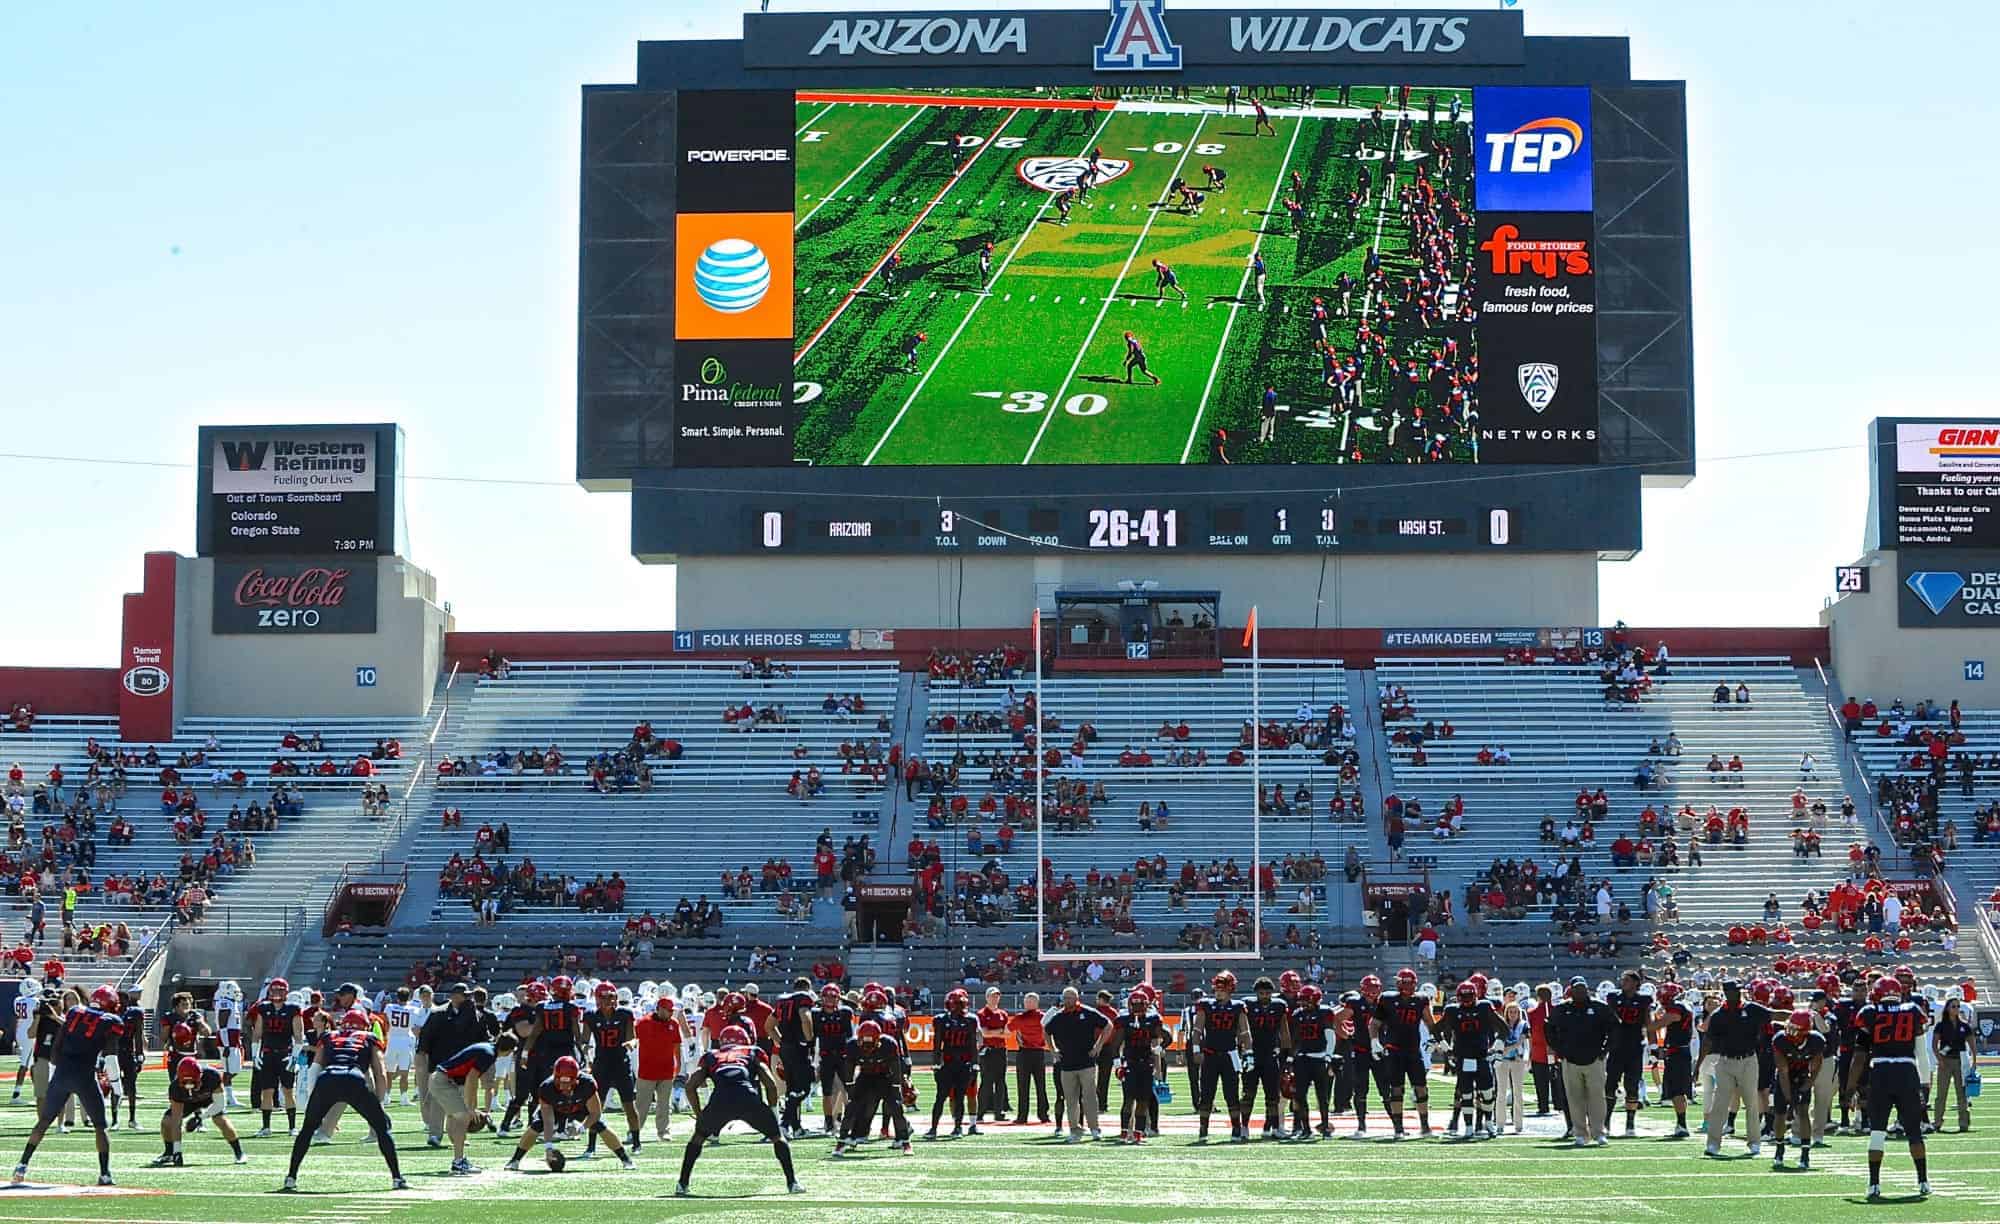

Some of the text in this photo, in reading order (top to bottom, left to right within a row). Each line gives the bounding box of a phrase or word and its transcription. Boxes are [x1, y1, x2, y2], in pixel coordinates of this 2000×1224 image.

[809, 0, 1468, 71] ARIZONA A WILDCATS
[687, 150, 787, 162] POWERADE
[1485, 133, 1573, 173] TEP
[1480, 225, 1589, 279] fry's
[1506, 241, 1581, 250] FOOD STORES
[1505, 285, 1570, 299] fresh food,
[1482, 301, 1594, 315] famous low prices
[682, 382, 782, 406] Pima federal
[681, 425, 785, 439] Smart. Simple. Personal.
[1482, 430, 1596, 440] NETWORKS
[1938, 429, 2000, 446] GIAN
[273, 440, 366, 456] Western
[273, 456, 366, 473] Refining
[273, 474, 353, 486] Fueling Our Lives
[1941, 474, 1972, 484] Fueling
[226, 493, 342, 503] Out of Town Scoreboard
[1917, 487, 1952, 496] Thanks
[1953, 487, 1965, 496] to
[1966, 488, 1984, 496] our
[231, 512, 277, 521] Colorado
[941, 510, 953, 532] 3
[1276, 509, 1287, 531] 1
[1321, 509, 1334, 531] 3
[231, 526, 300, 538] Oregon State
[763, 512, 782, 547] 0
[829, 522, 871, 537] ARIZONA
[1088, 509, 1178, 547] 26:41
[1399, 520, 1446, 535] WASH ST.
[1490, 509, 1509, 545] 0
[334, 540, 374, 550] 7:30 PM
[978, 536, 1007, 546] DOWN
[1209, 535, 1248, 545] BALL ON
[1272, 535, 1291, 545] QTR
[1838, 568, 1861, 590] 25
[1971, 572, 2000, 585] DE
[257, 608, 320, 627] zero
[676, 634, 691, 648] 11
[702, 634, 740, 646] FOLK
[744, 634, 803, 646] HEROES
[1387, 632, 1492, 644] #TEAMKADEEM
[1585, 632, 1602, 645] 13
[1129, 644, 1147, 657] 12
[356, 669, 376, 685] 10
[1965, 663, 1984, 678] 14
[873, 888, 899, 896] SECTION
[15, 1002, 28, 1019] 98
[391, 1011, 410, 1028] 50
[1873, 1013, 1914, 1044] 28
